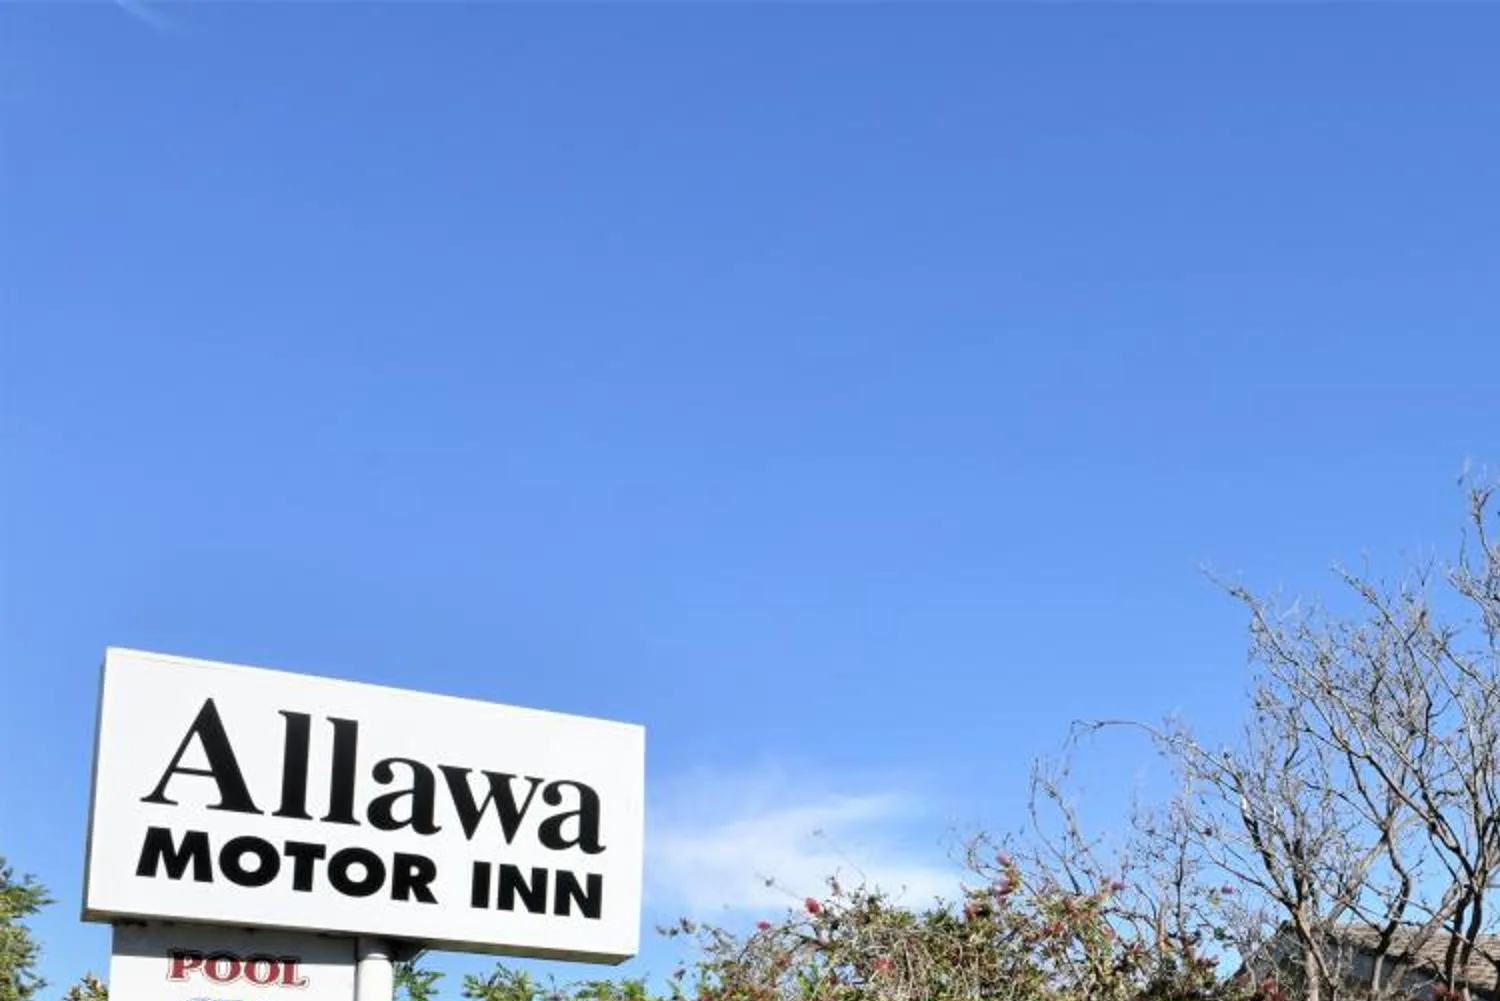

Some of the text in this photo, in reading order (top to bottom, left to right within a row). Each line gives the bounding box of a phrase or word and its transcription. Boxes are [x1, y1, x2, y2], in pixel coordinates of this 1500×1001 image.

[140, 697, 607, 855] Allawa
[135, 826, 604, 920] MOTOR INN
[167, 947, 308, 988] POOL
